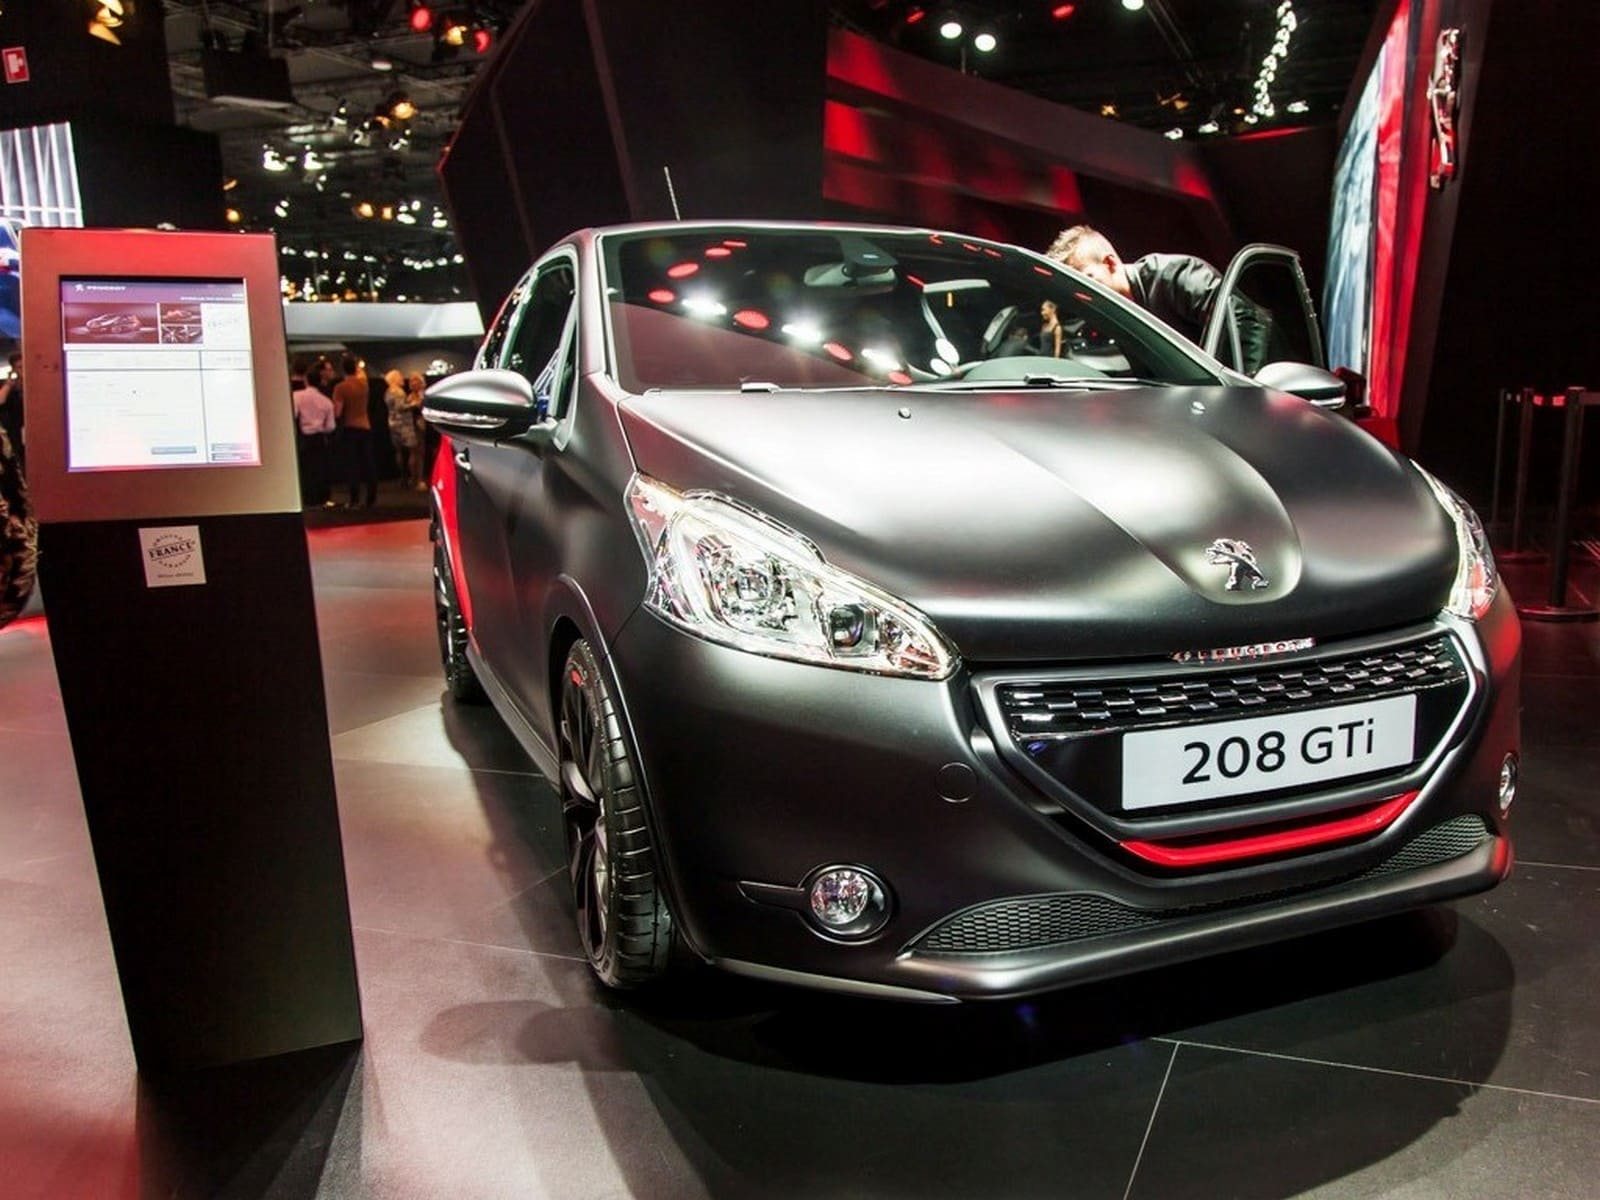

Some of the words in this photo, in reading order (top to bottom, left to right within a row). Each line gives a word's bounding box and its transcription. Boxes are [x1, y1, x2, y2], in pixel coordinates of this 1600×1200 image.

[149, 541, 192, 559] FRANCE
[1182, 730, 1287, 785] 208
[1301, 718, 1375, 765] GTi
